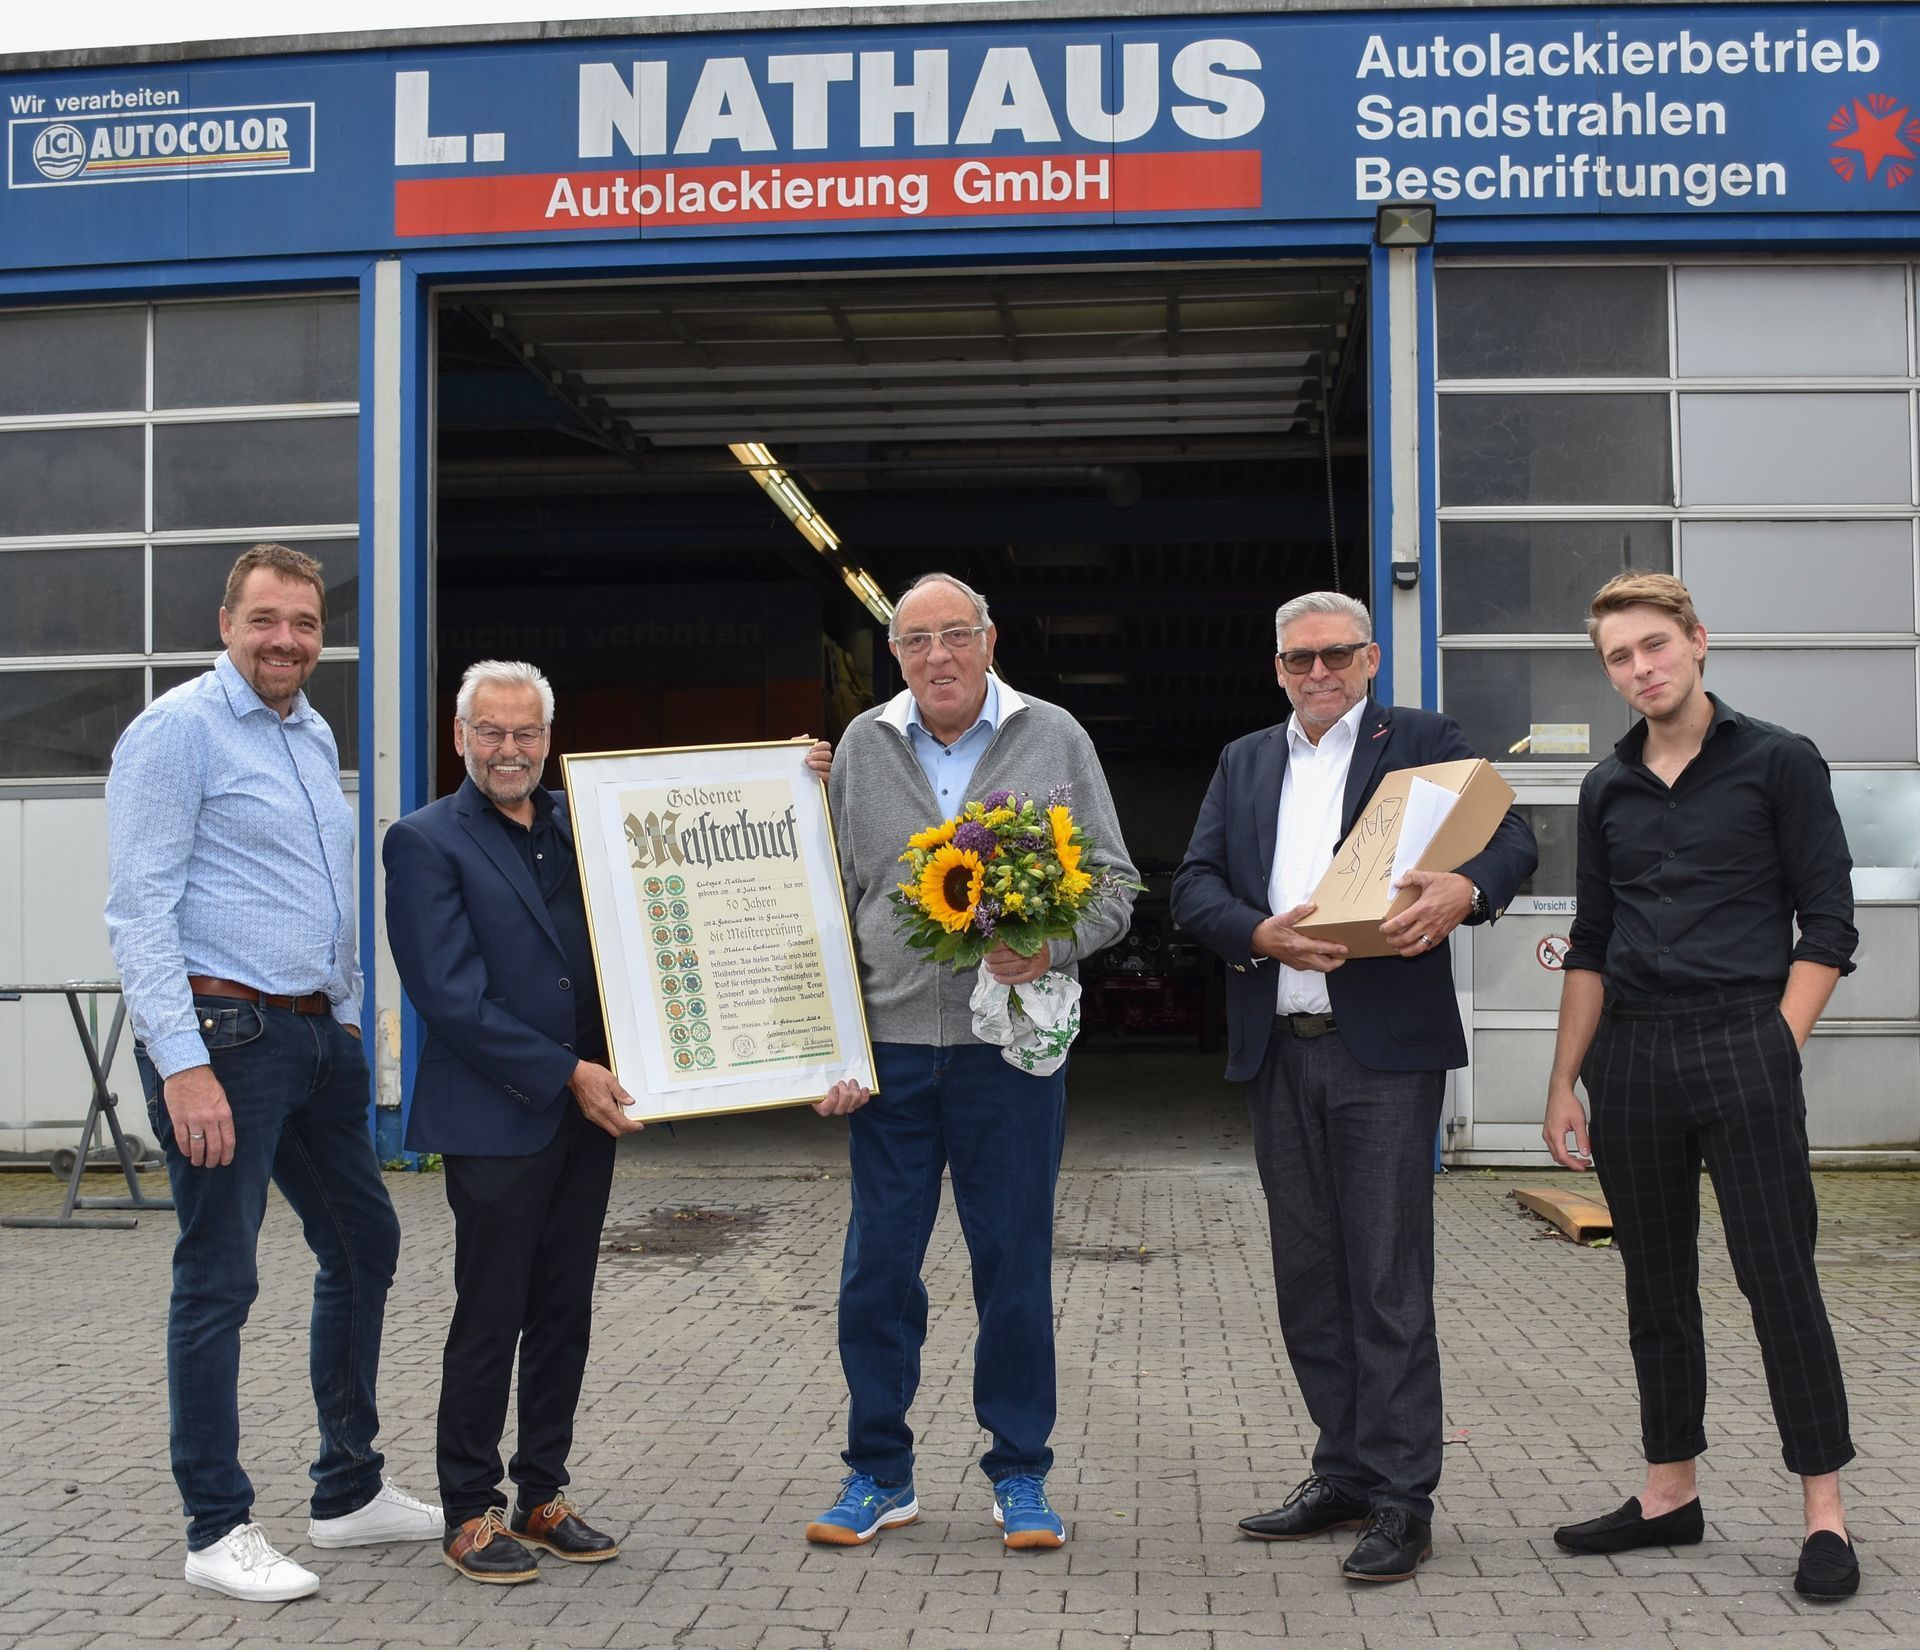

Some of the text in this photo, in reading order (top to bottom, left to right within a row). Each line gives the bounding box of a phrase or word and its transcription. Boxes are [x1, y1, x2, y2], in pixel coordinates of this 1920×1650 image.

[1355, 28, 1881, 79] Autolackierbetrieb
[10, 89, 180, 115] Wir verarbeiten
[394, 38, 1266, 166] L. NATHAUS
[1355, 91, 1727, 141] Sandstrahlen
[45, 132, 75, 155] ICI
[90, 117, 289, 160] AUTOCOLOR
[544, 158, 1111, 219] Autolackierung GmbH
[1355, 153, 1787, 207] Beschriftungen
[584, 617, 762, 648] verboten
[666, 787, 742, 808] Goldener
[623, 804, 799, 870] Meisterbrief
[726, 896, 777, 912] 50 Jahren
[1533, 900, 1567, 911] Vorsicht
[710, 923, 804, 942] die Meisterprüfung
